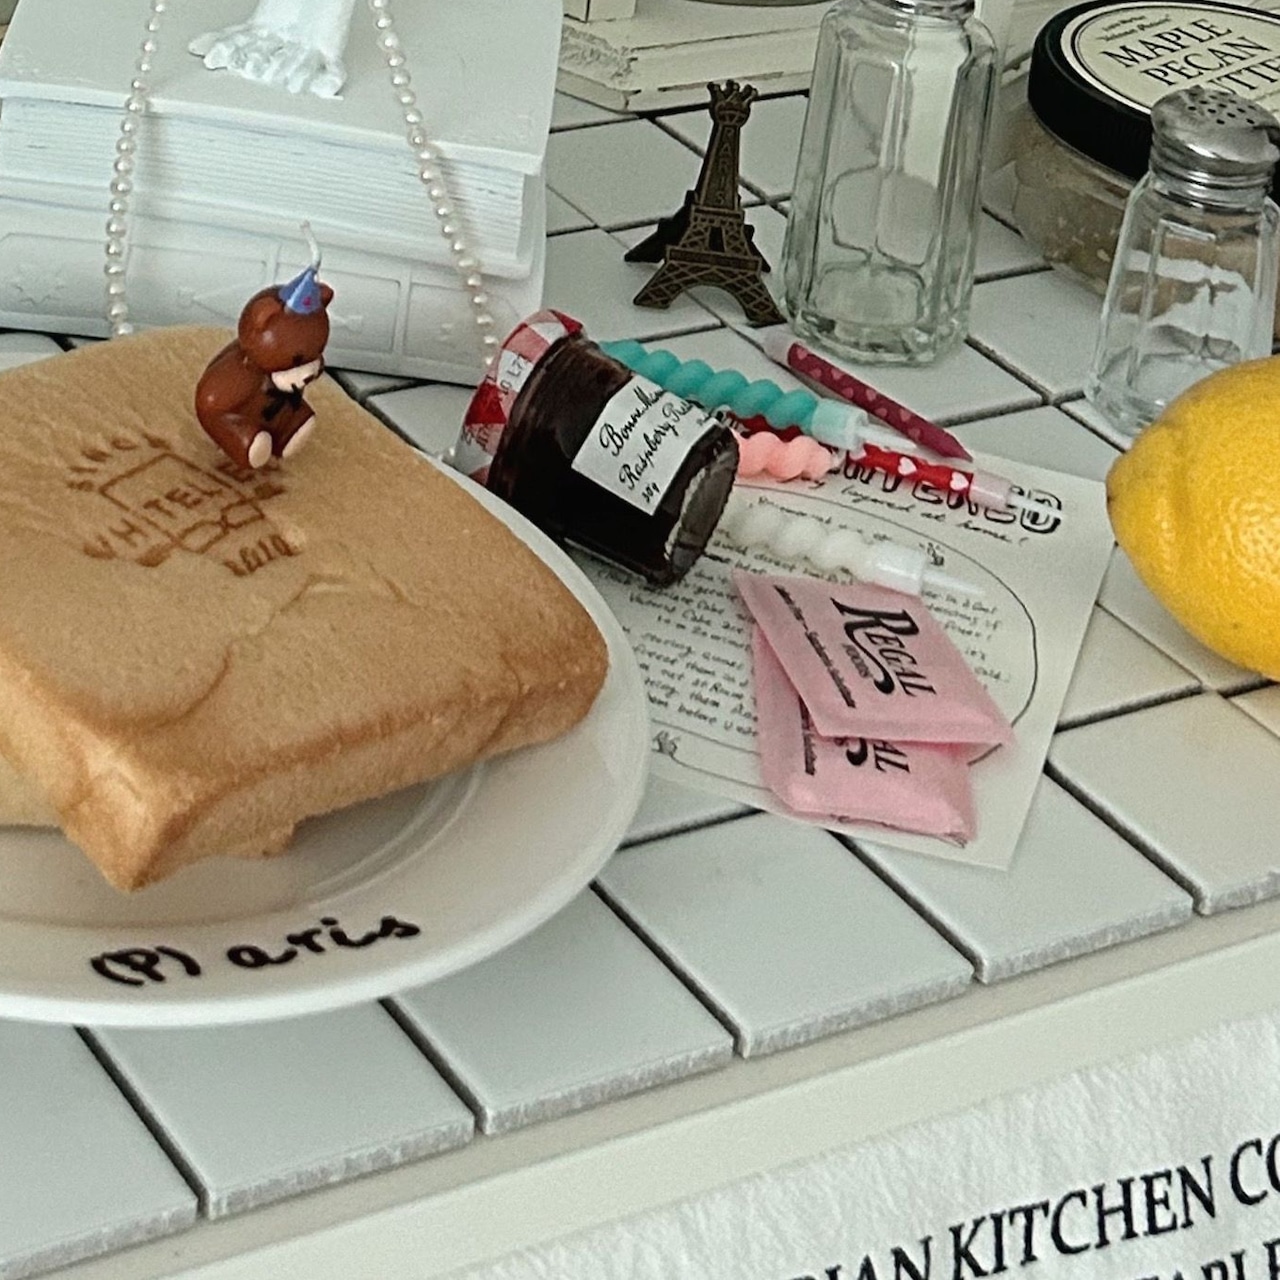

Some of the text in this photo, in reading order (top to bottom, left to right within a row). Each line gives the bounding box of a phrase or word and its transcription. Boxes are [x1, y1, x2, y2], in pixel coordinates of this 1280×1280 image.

[1098, 18, 1233, 68] MAPLE
[1140, 36, 1272, 87] PECAN
[618, 420, 680, 491] Raspberry
[829, 596, 938, 698] REGAL
[948, 1154, 1217, 1280] KITCHEN
